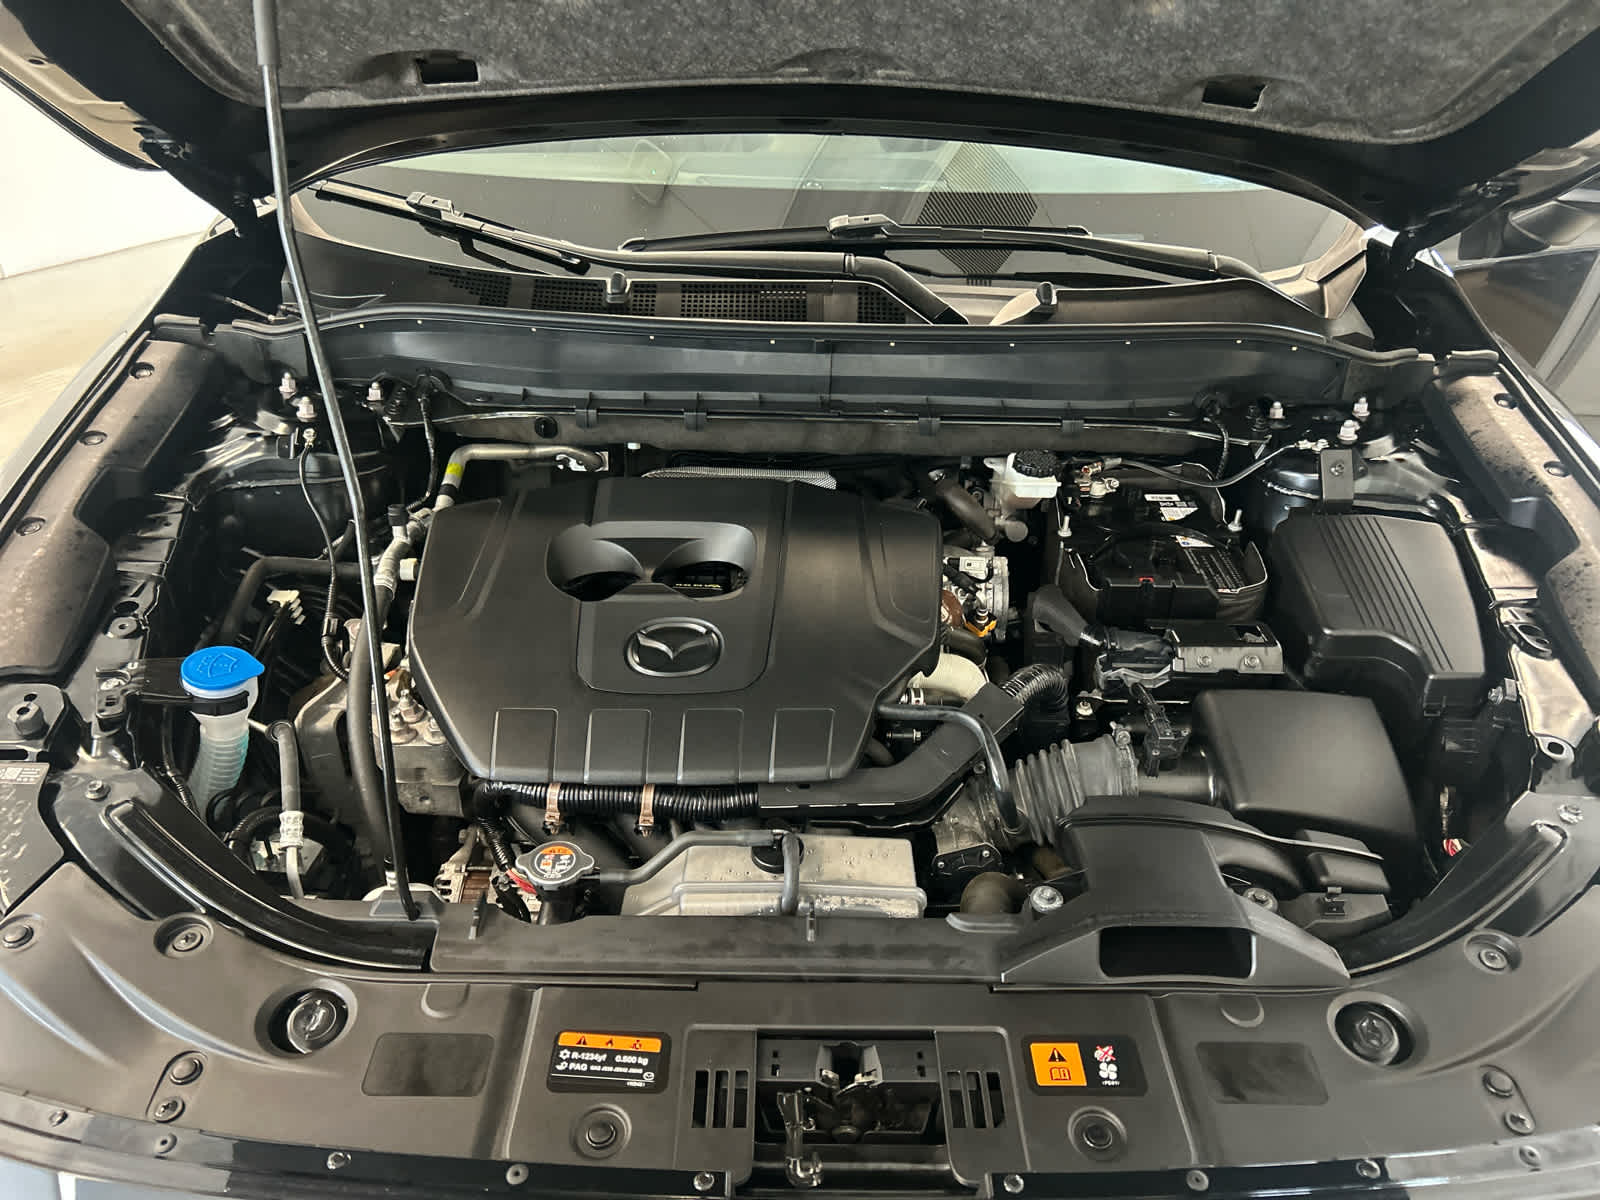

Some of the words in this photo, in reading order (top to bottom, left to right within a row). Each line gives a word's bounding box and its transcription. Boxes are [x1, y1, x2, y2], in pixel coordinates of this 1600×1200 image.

[571, 1051, 607, 1062] R-1234yf
[638, 1057, 649, 1066] kg
[569, 1063, 588, 1071] PAG
